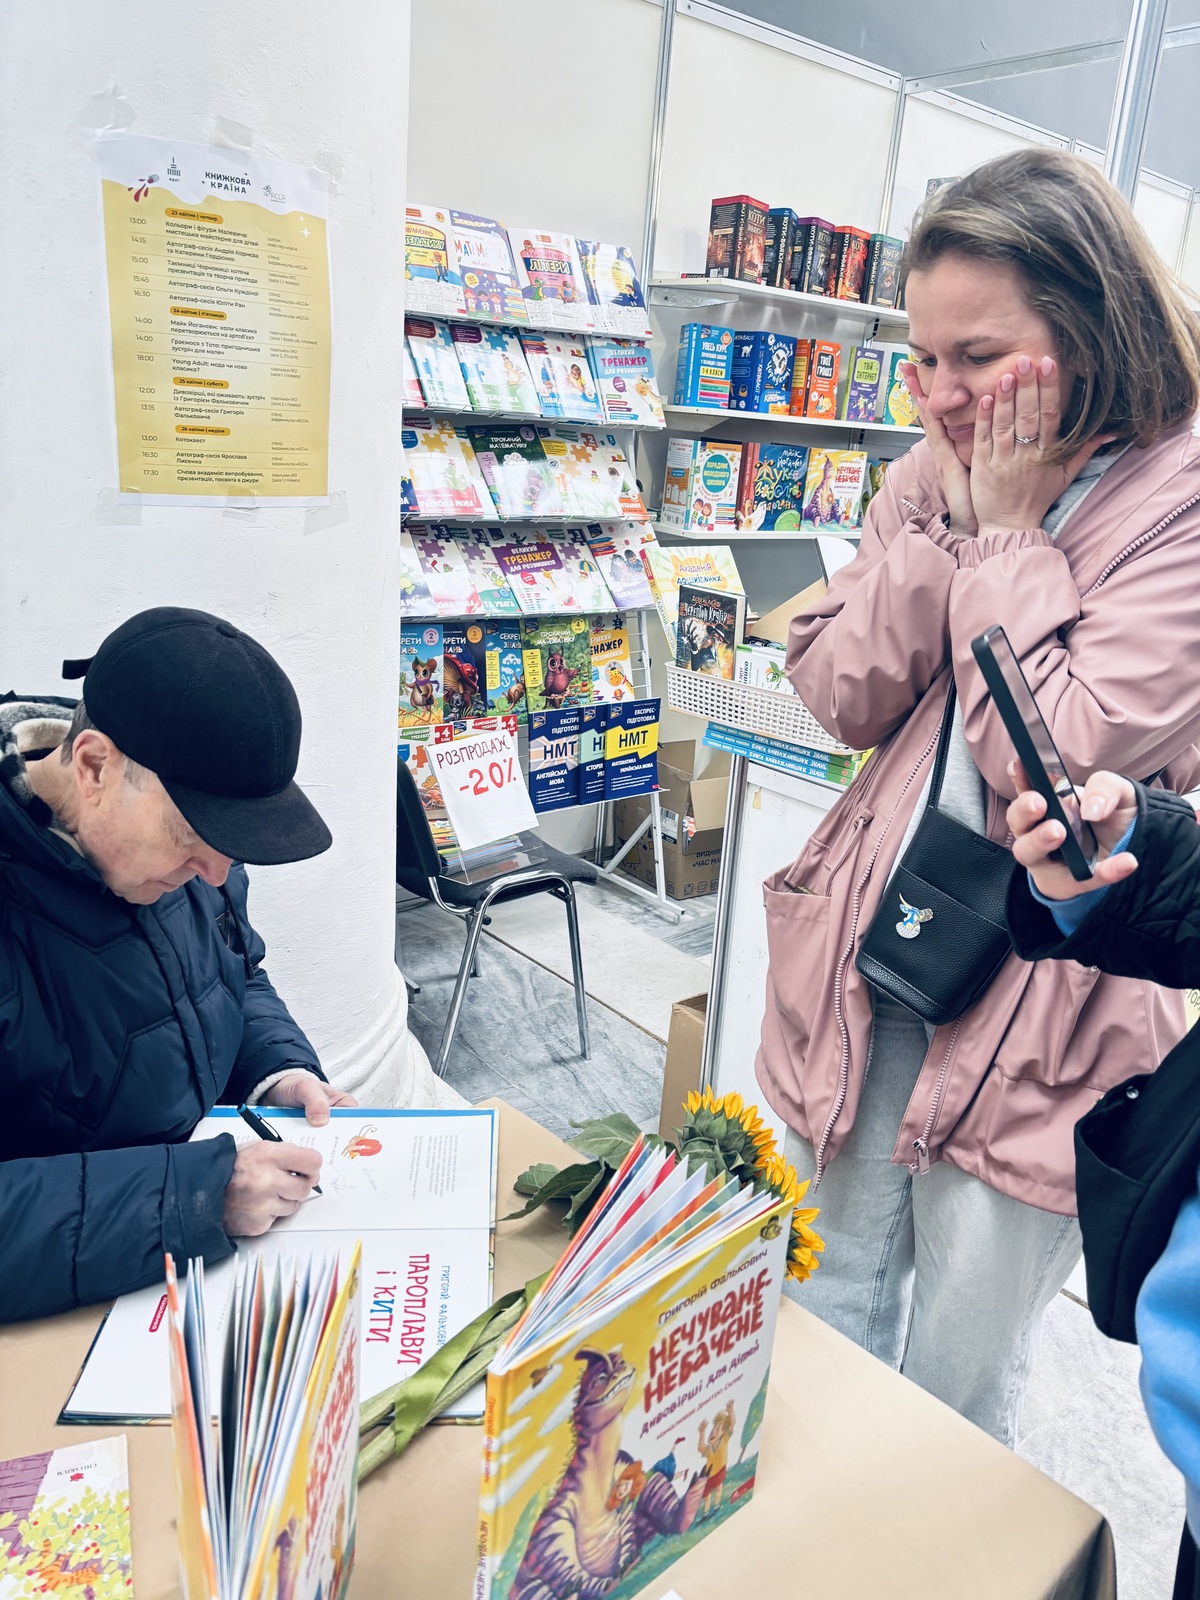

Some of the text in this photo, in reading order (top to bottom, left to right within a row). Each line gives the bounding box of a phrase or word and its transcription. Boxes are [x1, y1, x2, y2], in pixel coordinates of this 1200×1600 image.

[205, 172, 251, 186] КНИЖКОВА
[210, 182, 247, 194] КРАЇНА
[129, 217, 146, 225] 13:00
[132, 256, 148, 264] 15:00
[530, 259, 570, 273] ЛІТЕРИ
[172, 358, 191, 366] Young
[601, 357, 647, 367] ТРЕНАЖЕР
[511, 546, 537, 554] ВЕЛИКИЙ
[503, 551, 552, 566] ТРЕНАЖЕР
[507, 717, 515, 726] 4
[627, 715, 656, 724] ПІДГОТОВКА
[442, 727, 450, 737] 4
[619, 730, 648, 748] НМТ
[436, 735, 510, 769] РОЗПРОДАЖ
[544, 741, 577, 760] НМТ
[611, 758, 636, 766] МАТЕМАТИКА
[459, 757, 517, 795] -20%
[536, 769, 567, 780] АНГЛІЙСЬКА
[440, 1266, 450, 1300] ГРИГОРІЙ
[658, 1248, 768, 1324] Григорій Фалькович
[366, 1285, 397, 1343] КИТИ
[397, 1254, 430, 1364] ПАРОПЛАВИ
[648, 1267, 773, 1376] НЕЧУВАНЕ-
[643, 1302, 764, 1413] НЕБАЧЕНЕ
[706, 1365, 727, 1388] для
[729, 1339, 759, 1372] дітей
